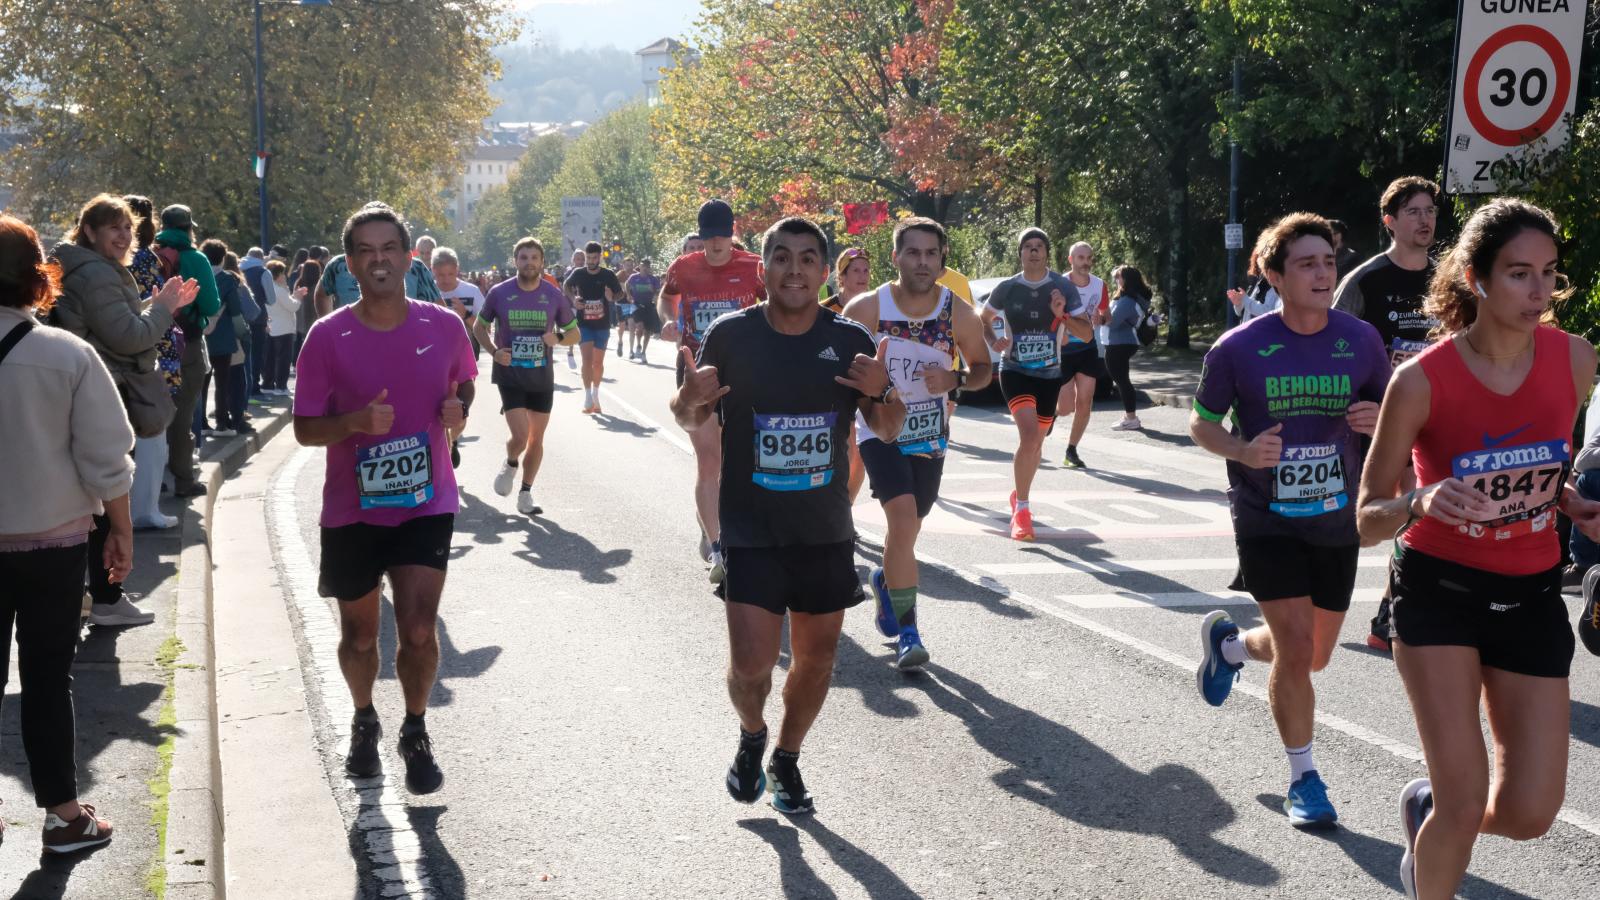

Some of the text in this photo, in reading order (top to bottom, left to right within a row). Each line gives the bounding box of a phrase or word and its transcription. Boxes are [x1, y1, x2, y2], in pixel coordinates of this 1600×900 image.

[1481, 0, 1569, 13] GUNEA
[1489, 68, 1547, 107] 30
[509, 310, 547, 320] BEHOBIA
[513, 343, 543, 353] 7316
[1019, 342, 1052, 354] 6721
[1265, 374, 1351, 398] BEHOBIA
[1268, 400, 1290, 411] SAN
[903, 412, 939, 431] 057
[762, 432, 829, 456] 9846
[362, 452, 426, 481] 7202
[784, 459, 810, 467] JORGE
[1280, 459, 1341, 487] 6204
[1300, 487, 1327, 497] IÑIGO
[1499, 501, 1526, 515] ANA
